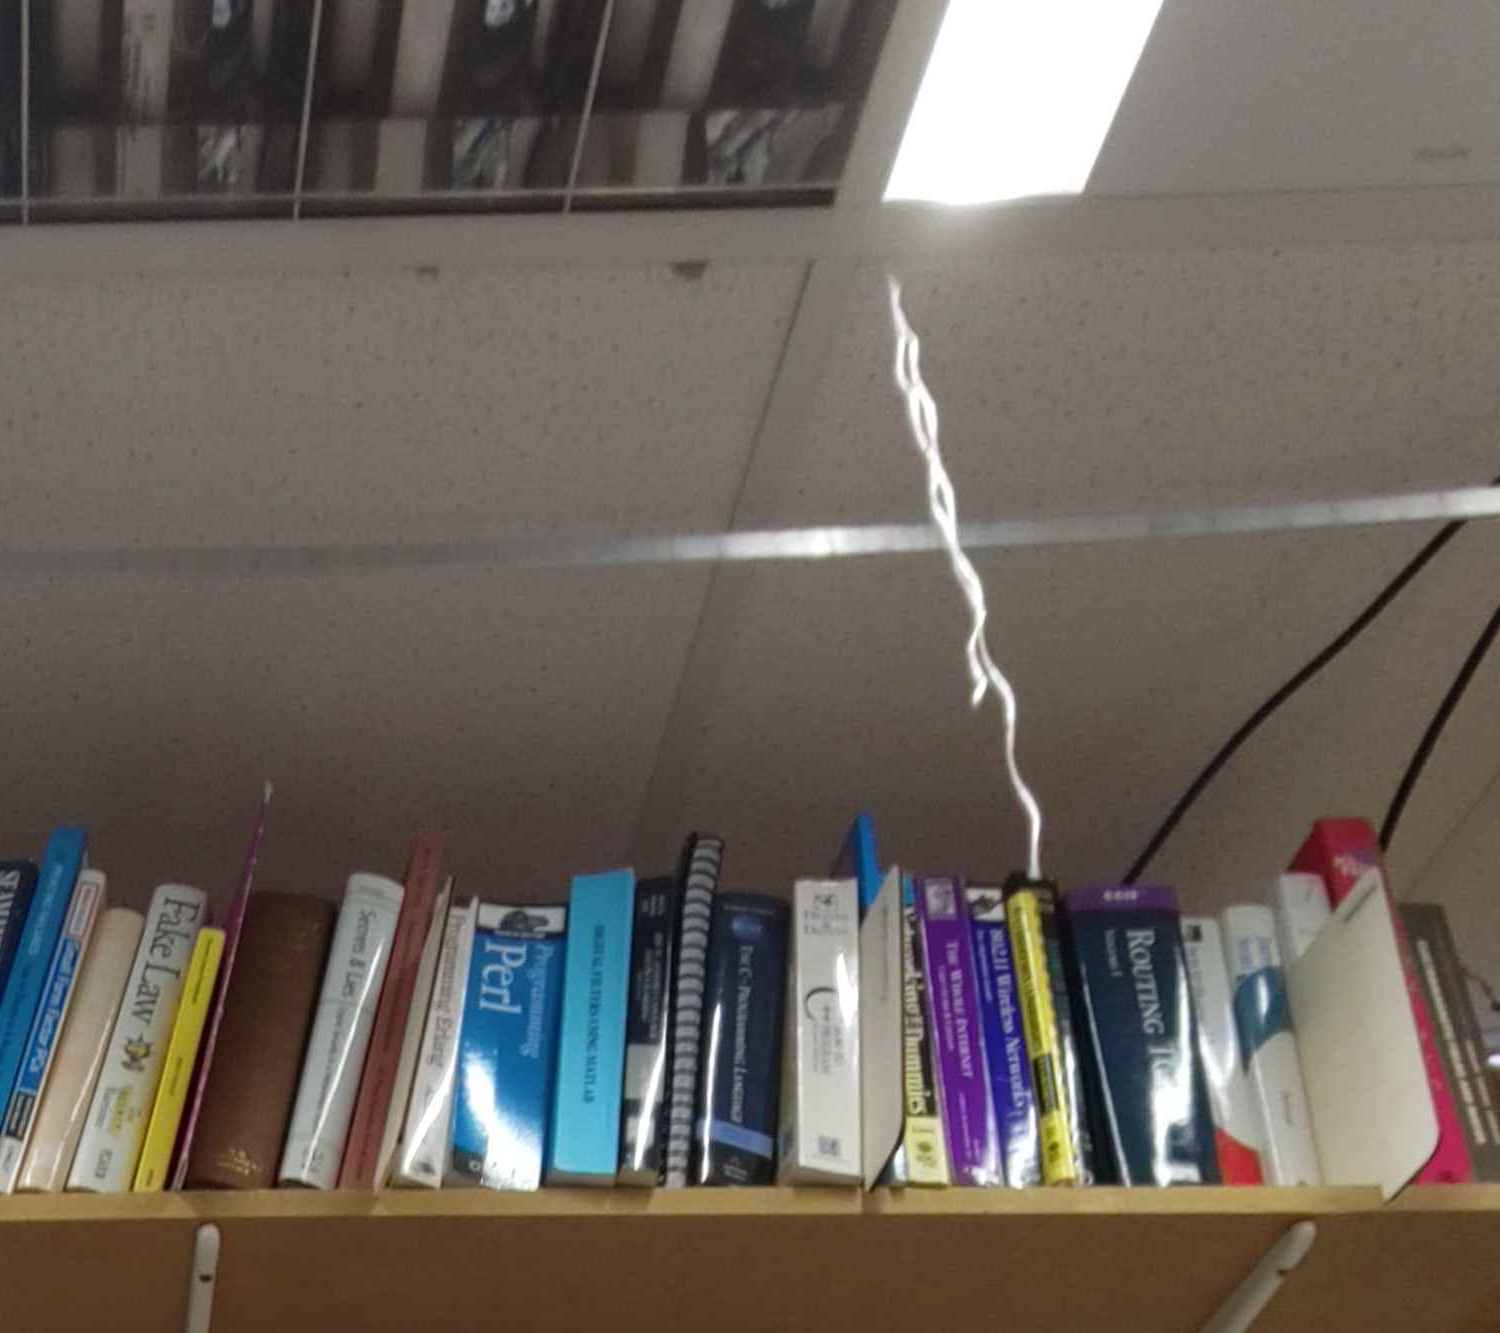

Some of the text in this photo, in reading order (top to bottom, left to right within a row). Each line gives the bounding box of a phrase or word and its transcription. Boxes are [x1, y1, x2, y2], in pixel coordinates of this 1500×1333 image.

[148, 896, 200, 960] Fake
[134, 961, 182, 1026] Law
[478, 938, 527, 1016] Perl
[519, 942, 553, 1060] Programming
[997, 974, 1016, 1033] Wireless
[1125, 925, 1165, 1036] ROUTING
[905, 1027, 930, 1115] Dummies
[956, 1017, 974, 1078] INTERNET
